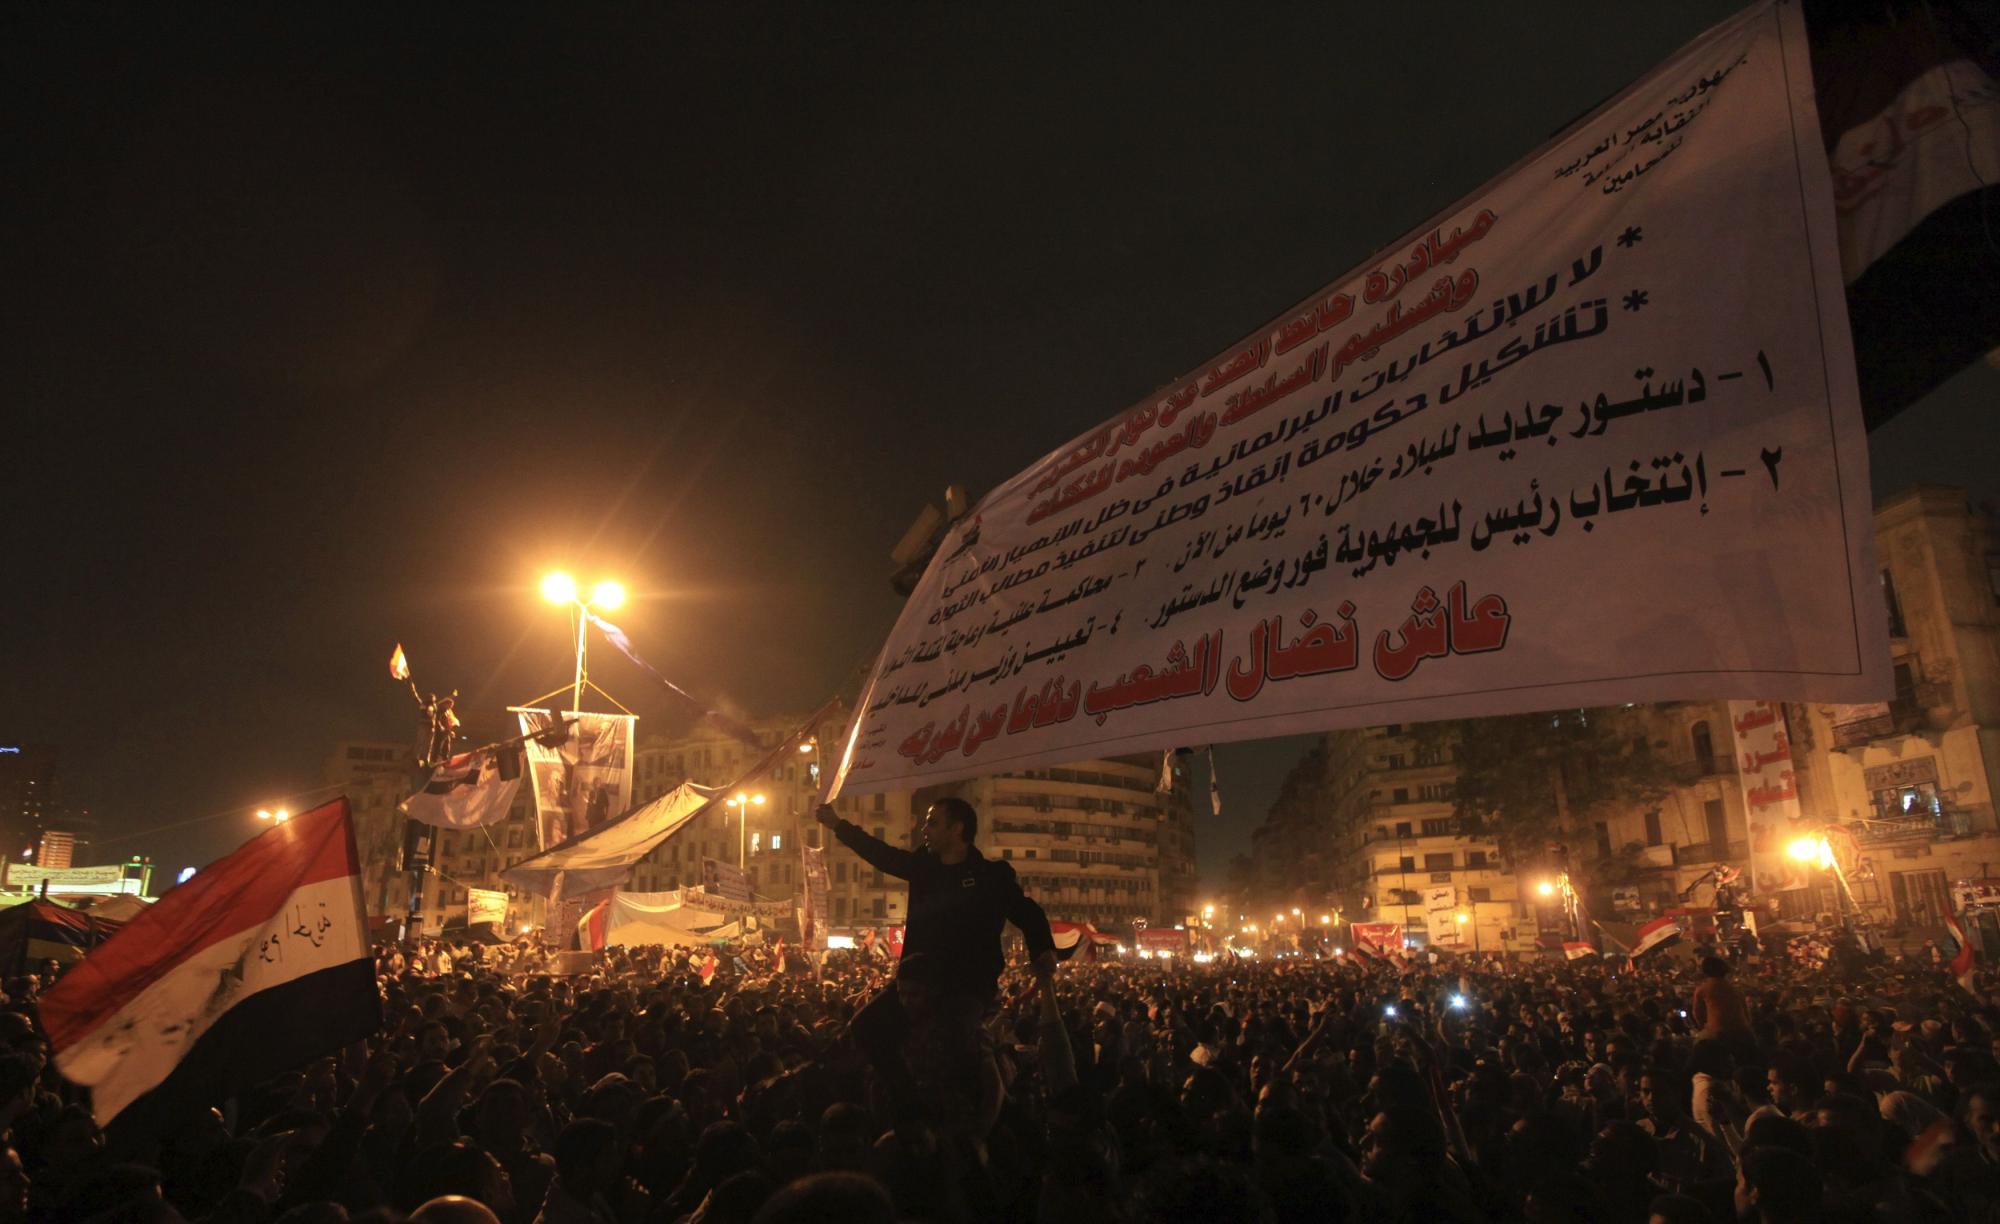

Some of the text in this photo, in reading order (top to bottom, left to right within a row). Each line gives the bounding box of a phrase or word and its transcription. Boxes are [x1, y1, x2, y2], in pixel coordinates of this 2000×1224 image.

[1553, 133, 1618, 180] العربية
[1623, 112, 1663, 146] مصر
[1362, 209, 1498, 305] مبادرة
[1568, 245, 1603, 287] لا
[1331, 267, 1479, 383] وتسليم
[1440, 297, 1608, 404] تشكيل
[1218, 340, 1330, 428] السلطة
[1570, 366, 1706, 439] دستور
[1179, 390, 1343, 488] البرلمانية
[1298, 393, 1427, 468] حكومة
[1388, 422, 1461, 480] للبلاد
[1468, 401, 1564, 460] جديد
[1214, 450, 1293, 506] إنقاذ
[1325, 456, 1384, 516] خلال
[1570, 450, 1709, 532] إنتخاب
[1082, 497, 1129, 534] ظل
[1212, 524, 1245, 560] من
[1335, 499, 1462, 578] للجمهورية
[1470, 477, 1560, 551] رئيس
[1052, 523, 1132, 572] لتنفيذ
[1284, 533, 1329, 589] فور
[979, 560, 1051, 605] مطالب
[1035, 574, 1113, 613] محاكمة
[1233, 557, 1286, 609] وضع
[1013, 615, 1096, 677] تعيين
[1226, 599, 1359, 702] نضال
[1373, 579, 1511, 681] عاش
[1005, 674, 1082, 735] دفاعا
[1083, 628, 1224, 727] الشعب
[962, 702, 1008, 757] عن
